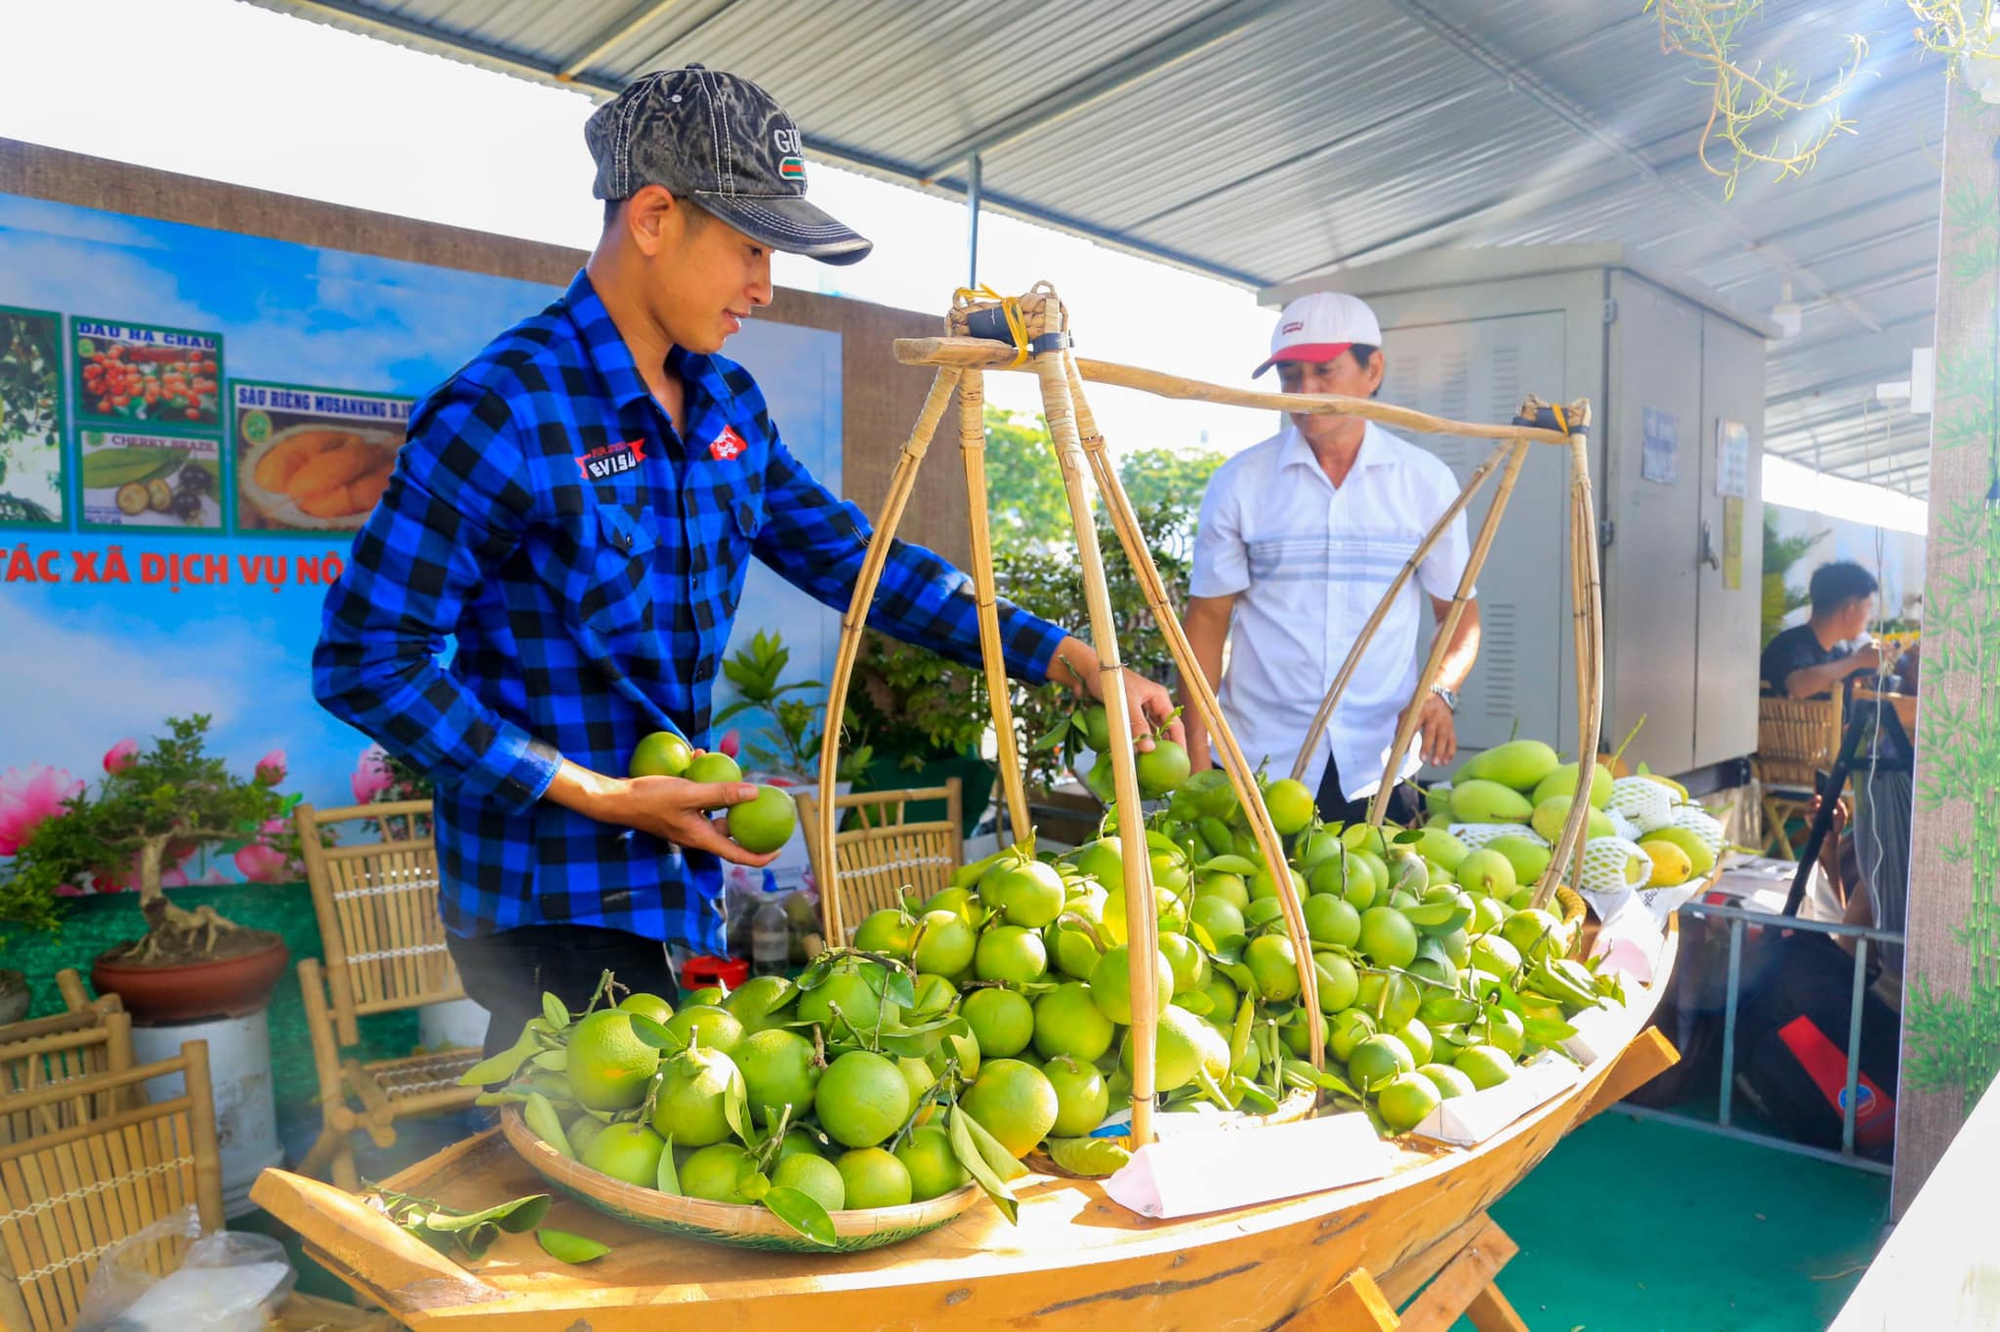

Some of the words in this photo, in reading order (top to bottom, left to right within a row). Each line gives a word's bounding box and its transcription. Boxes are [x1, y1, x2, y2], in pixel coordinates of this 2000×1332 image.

[71, 545, 131, 583] XÃ
[140, 551, 228, 594] DỊCH
[238, 554, 287, 594] VỤ
